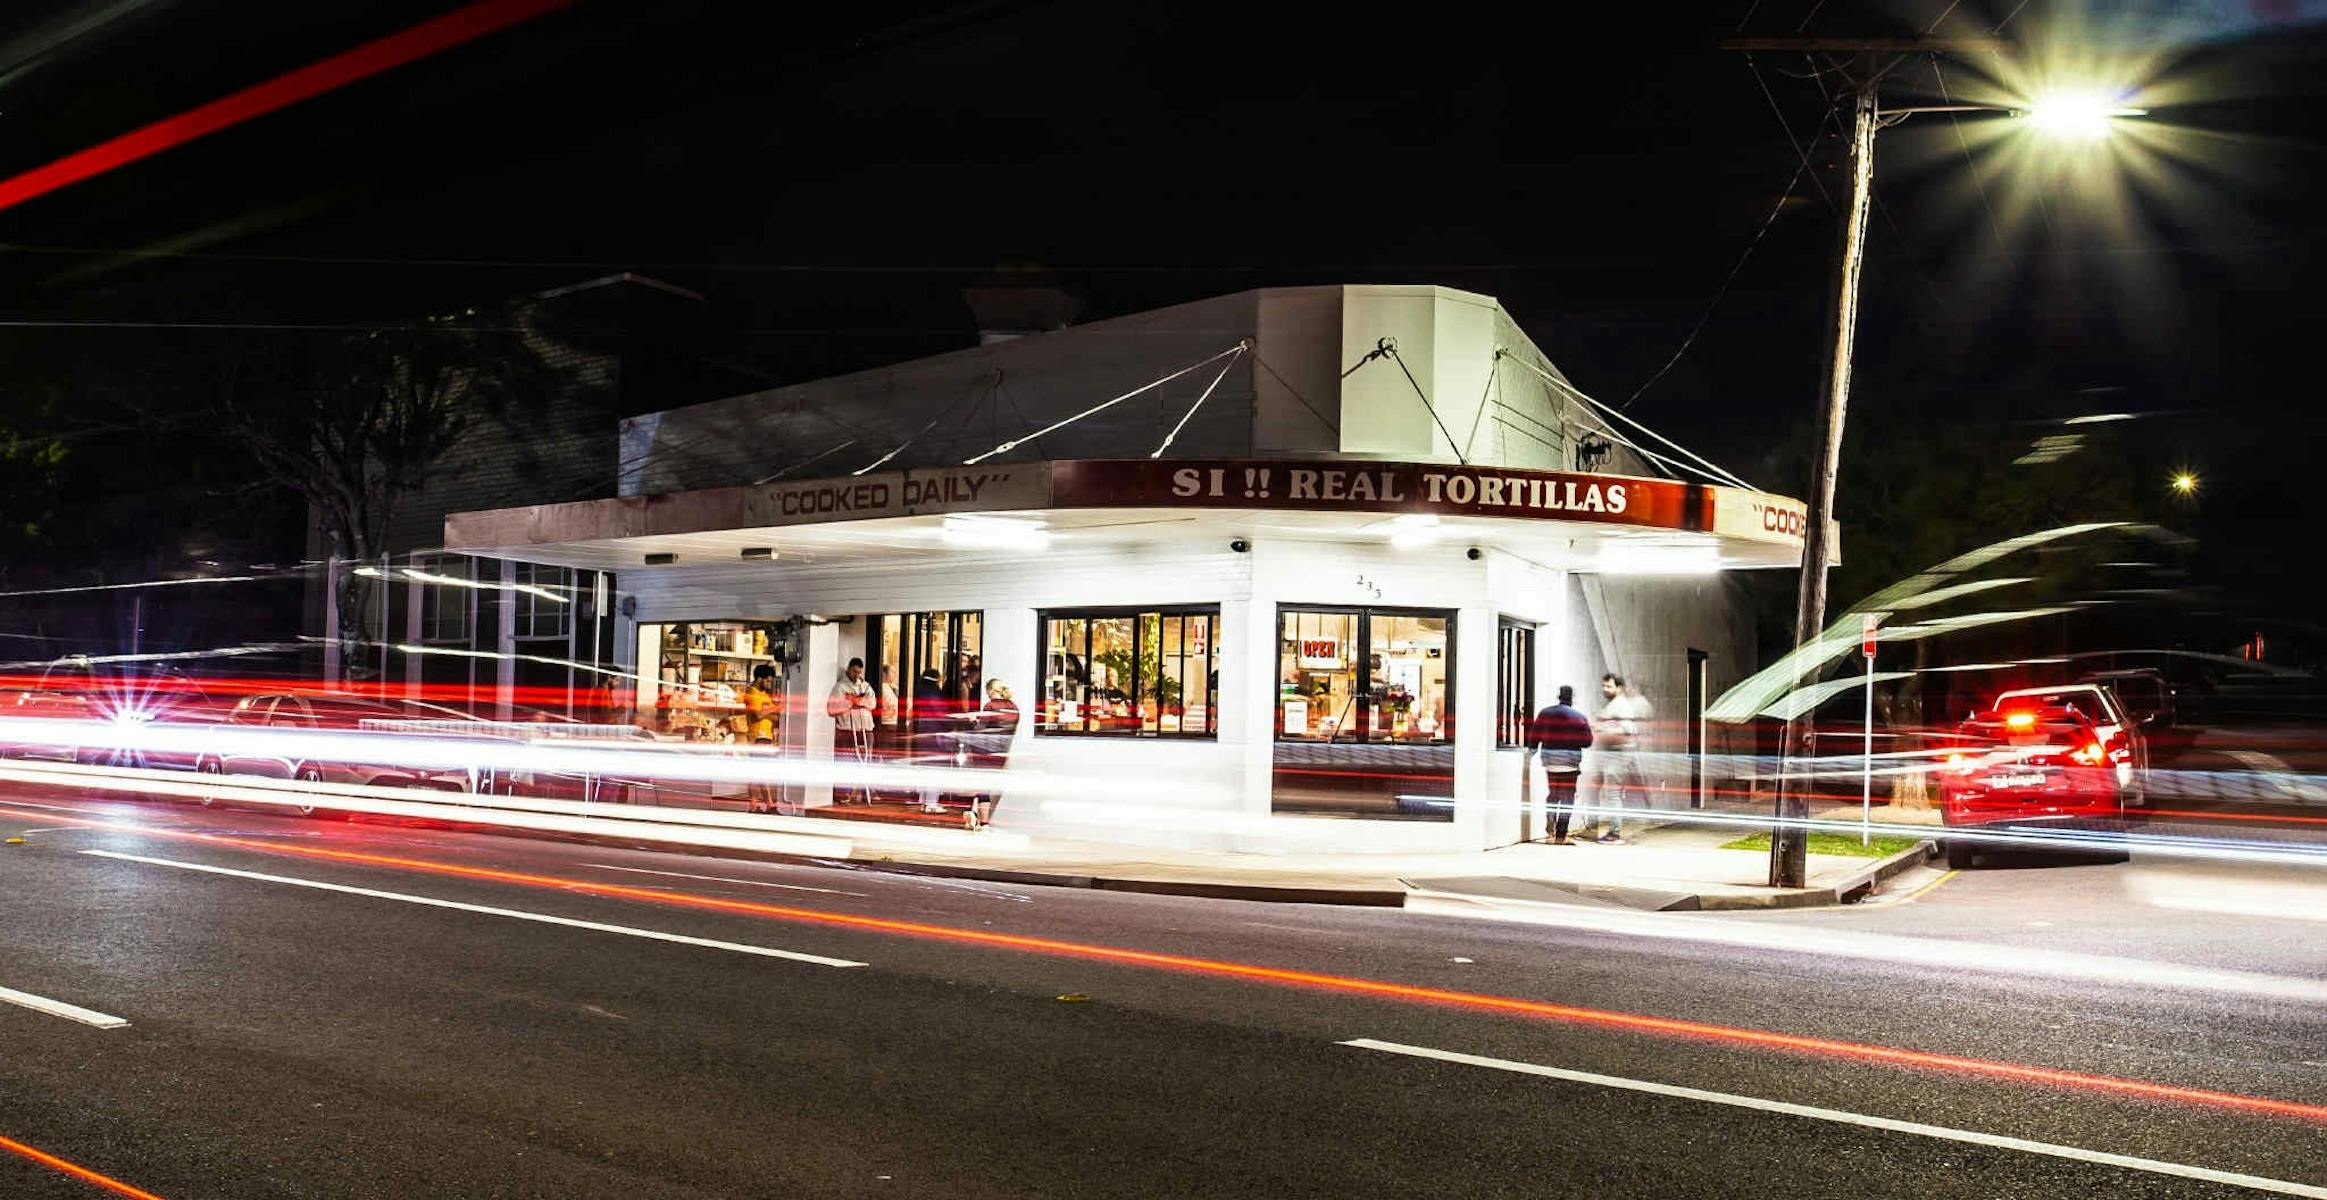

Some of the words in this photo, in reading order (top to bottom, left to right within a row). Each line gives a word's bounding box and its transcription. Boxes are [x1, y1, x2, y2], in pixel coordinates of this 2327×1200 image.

[1289, 469, 1404, 501] REAL
[1423, 473, 1627, 514] TORTILLAS
[1304, 640, 1335, 658] OPEN
